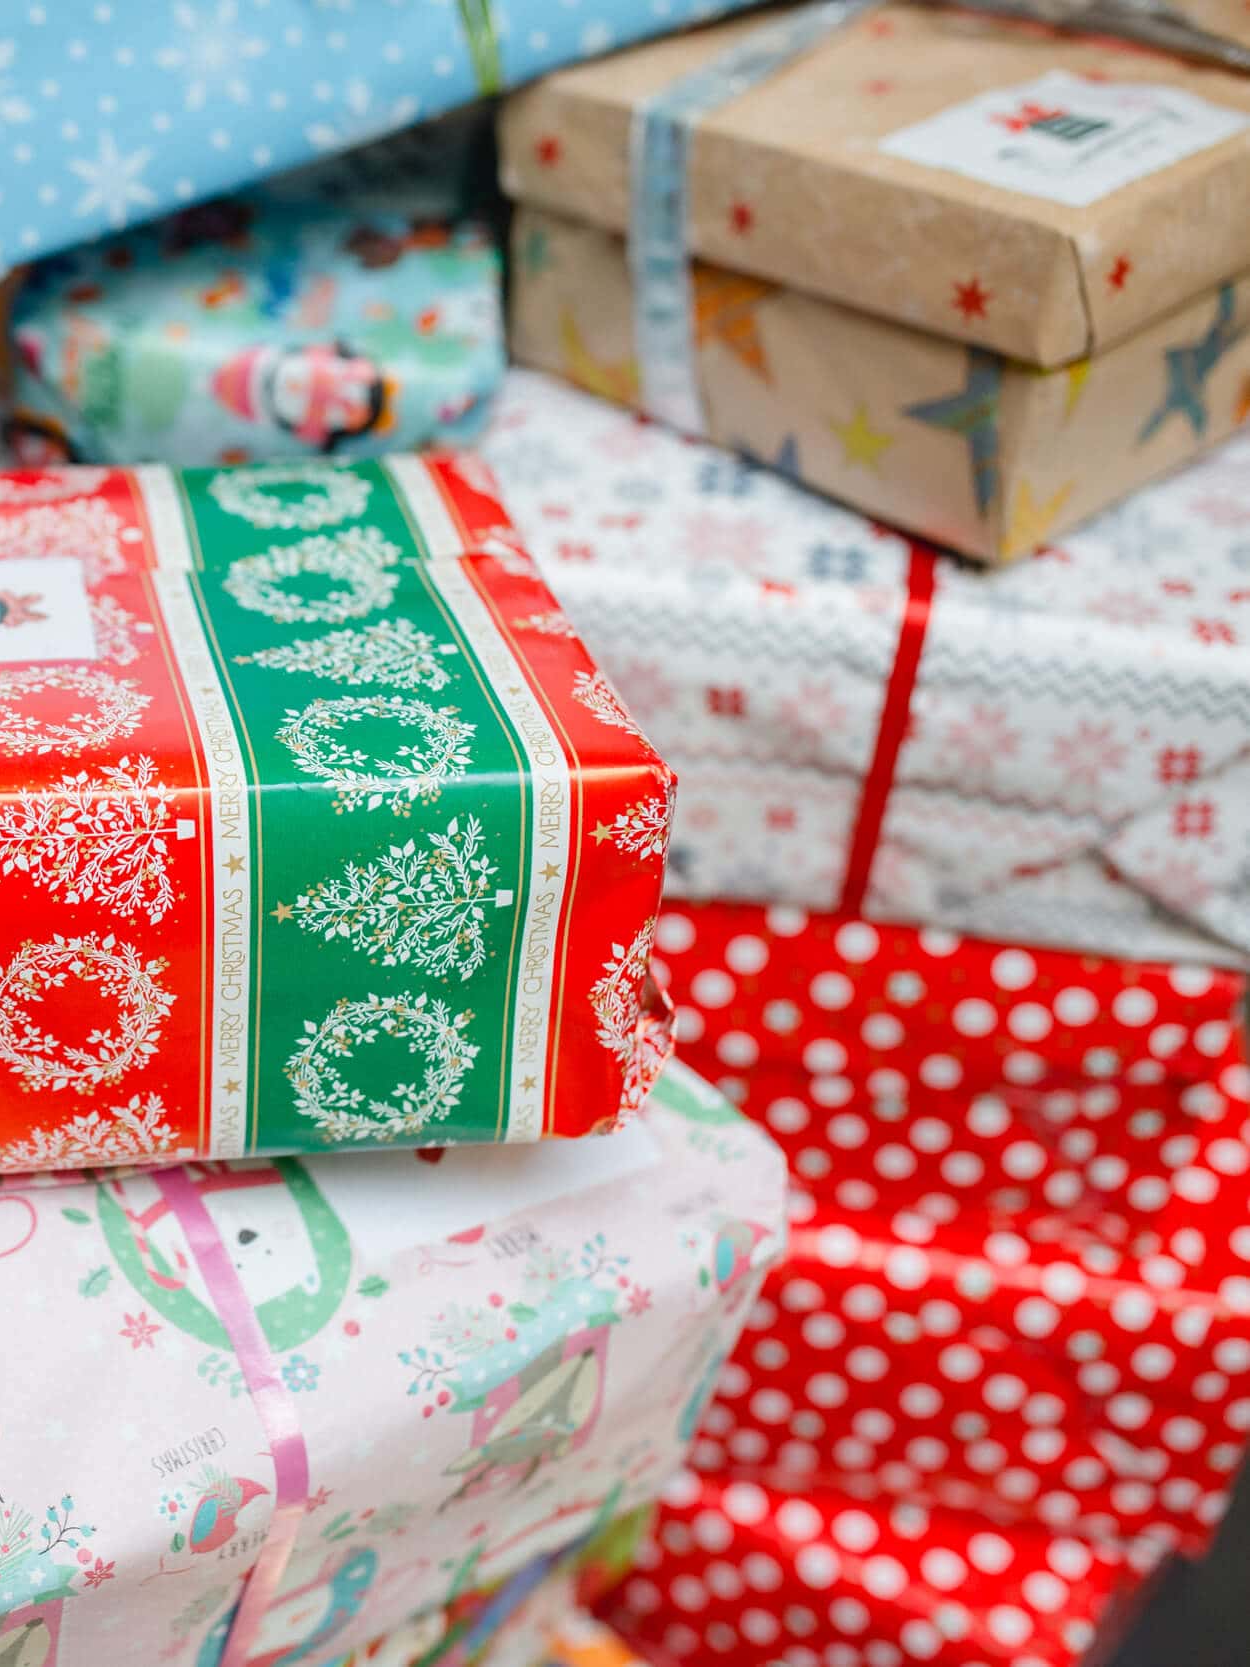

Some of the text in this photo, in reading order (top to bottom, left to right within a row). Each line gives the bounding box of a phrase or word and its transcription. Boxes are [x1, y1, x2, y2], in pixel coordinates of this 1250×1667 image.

[216, 769, 243, 840] MERRY
[540, 778, 565, 849] MERRY
[220, 888, 246, 1067] MERRY CHRISTMAS
[519, 891, 556, 1063] MERRY CHRISTMAS
[151, 1427, 227, 1479] CHRISTMAS
